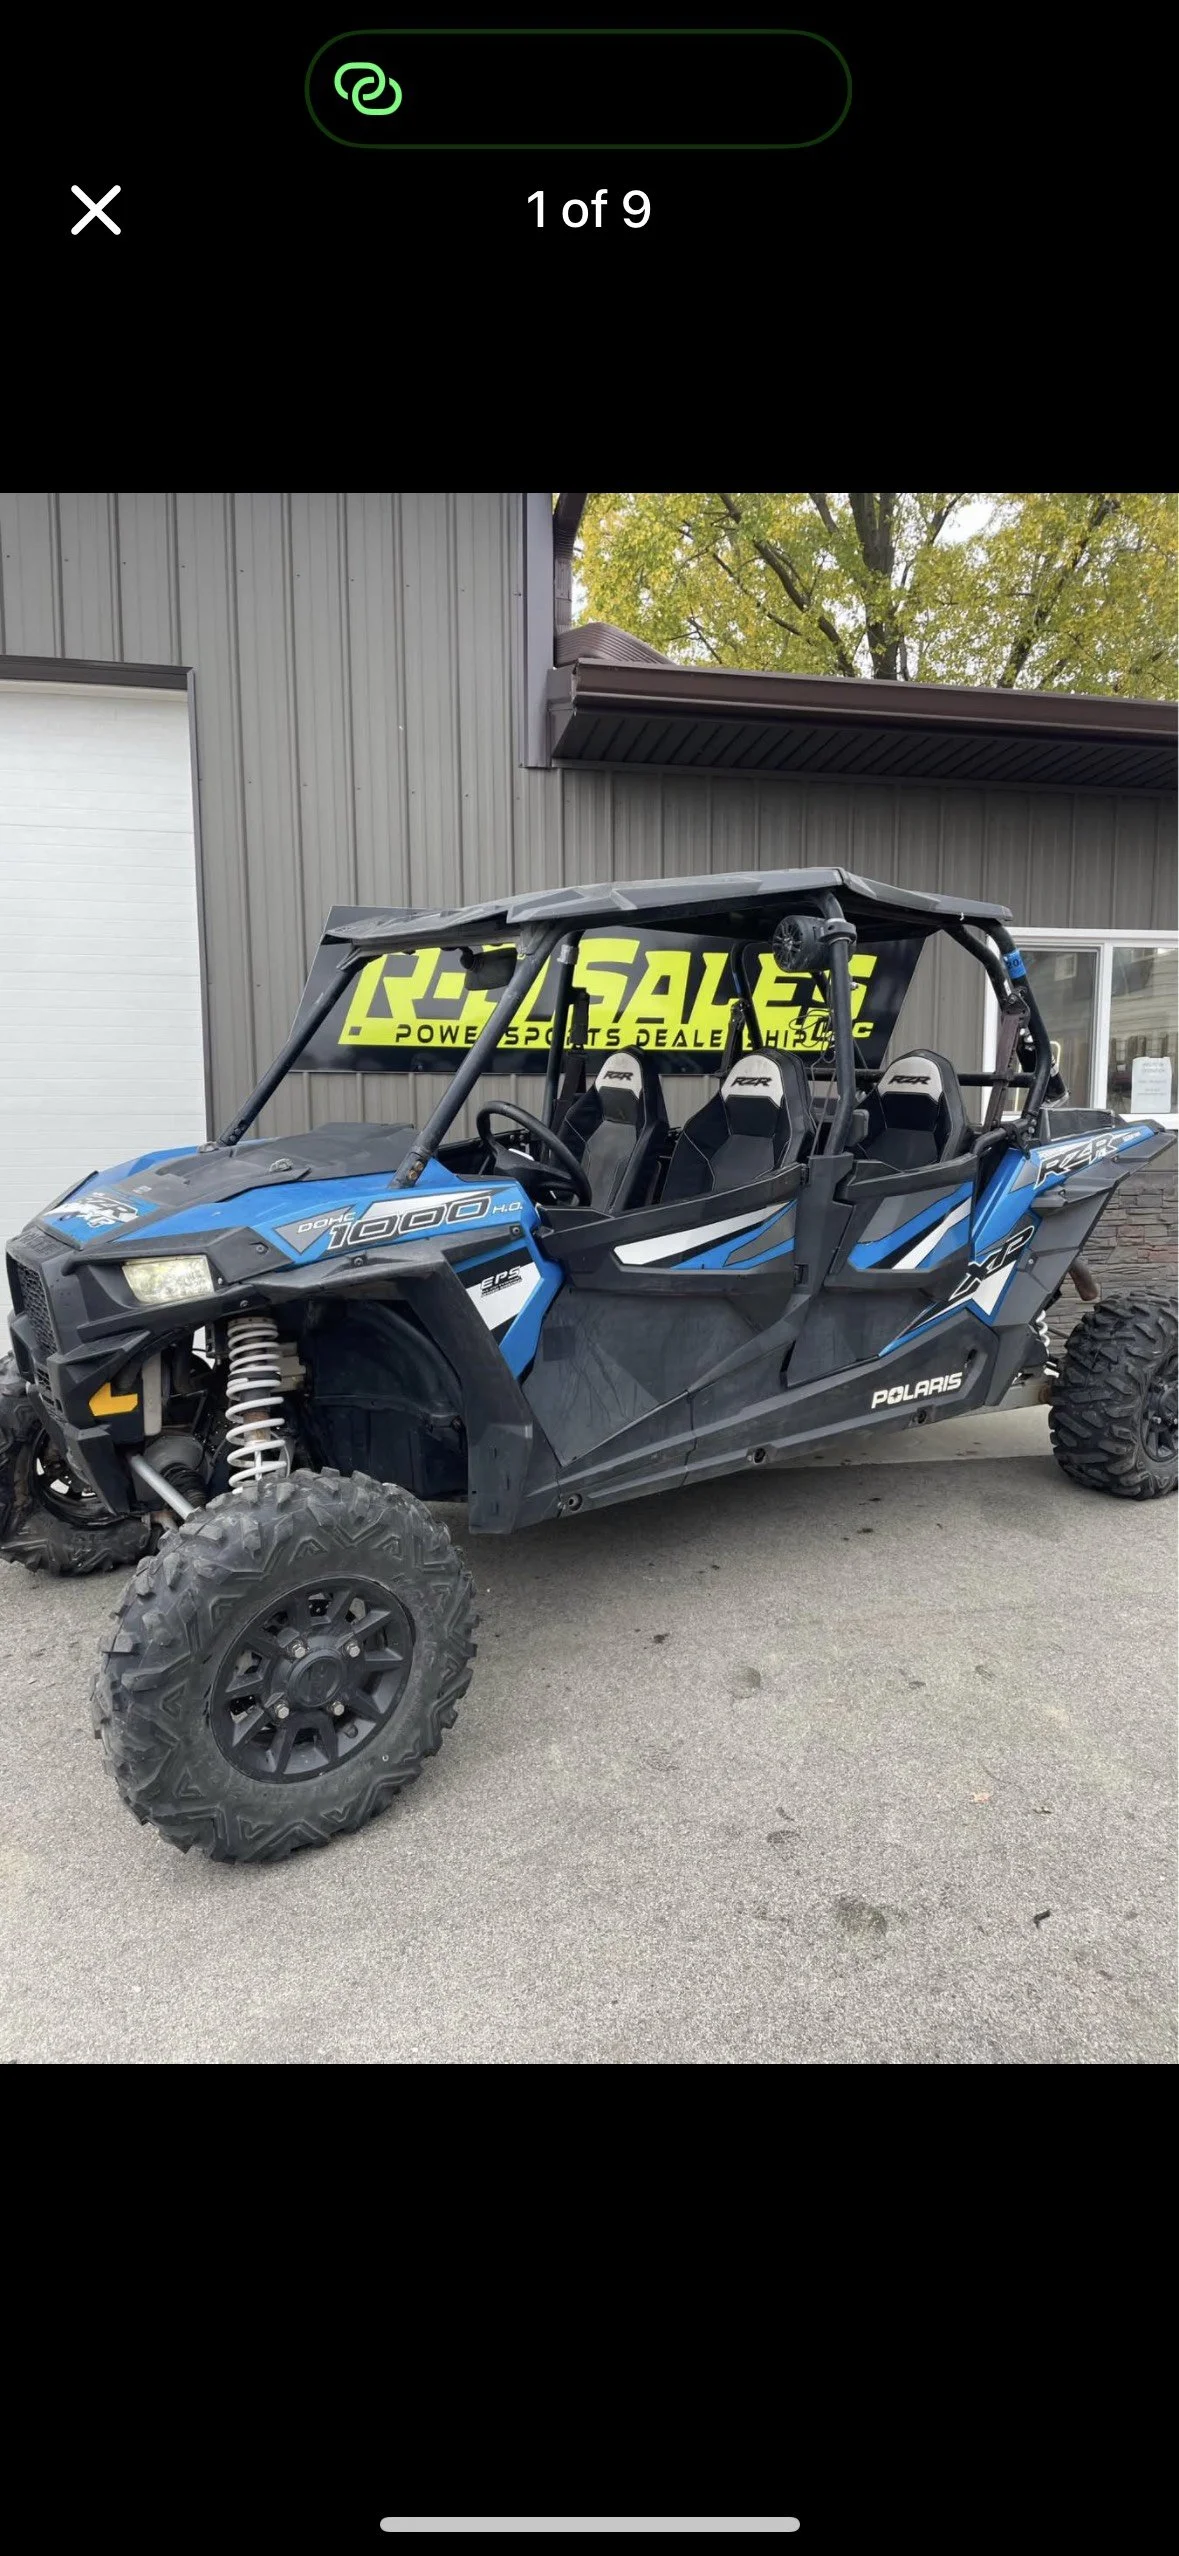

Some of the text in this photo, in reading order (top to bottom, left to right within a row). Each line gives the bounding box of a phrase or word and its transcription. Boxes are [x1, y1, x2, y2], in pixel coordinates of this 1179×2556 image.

[635, 1028, 807, 1048] DEALEHIP
[603, 1070, 634, 1081] RZR
[731, 1076, 773, 1087] RZR
[888, 1075, 931, 1085] RZR
[1034, 1132, 1118, 1190] RZR
[297, 1195, 523, 1251] DOHC 1000 H.O.
[947, 1225, 1035, 1302] XP
[480, 1265, 521, 1290] EPS
[870, 1371, 963, 1409] POLARIS
